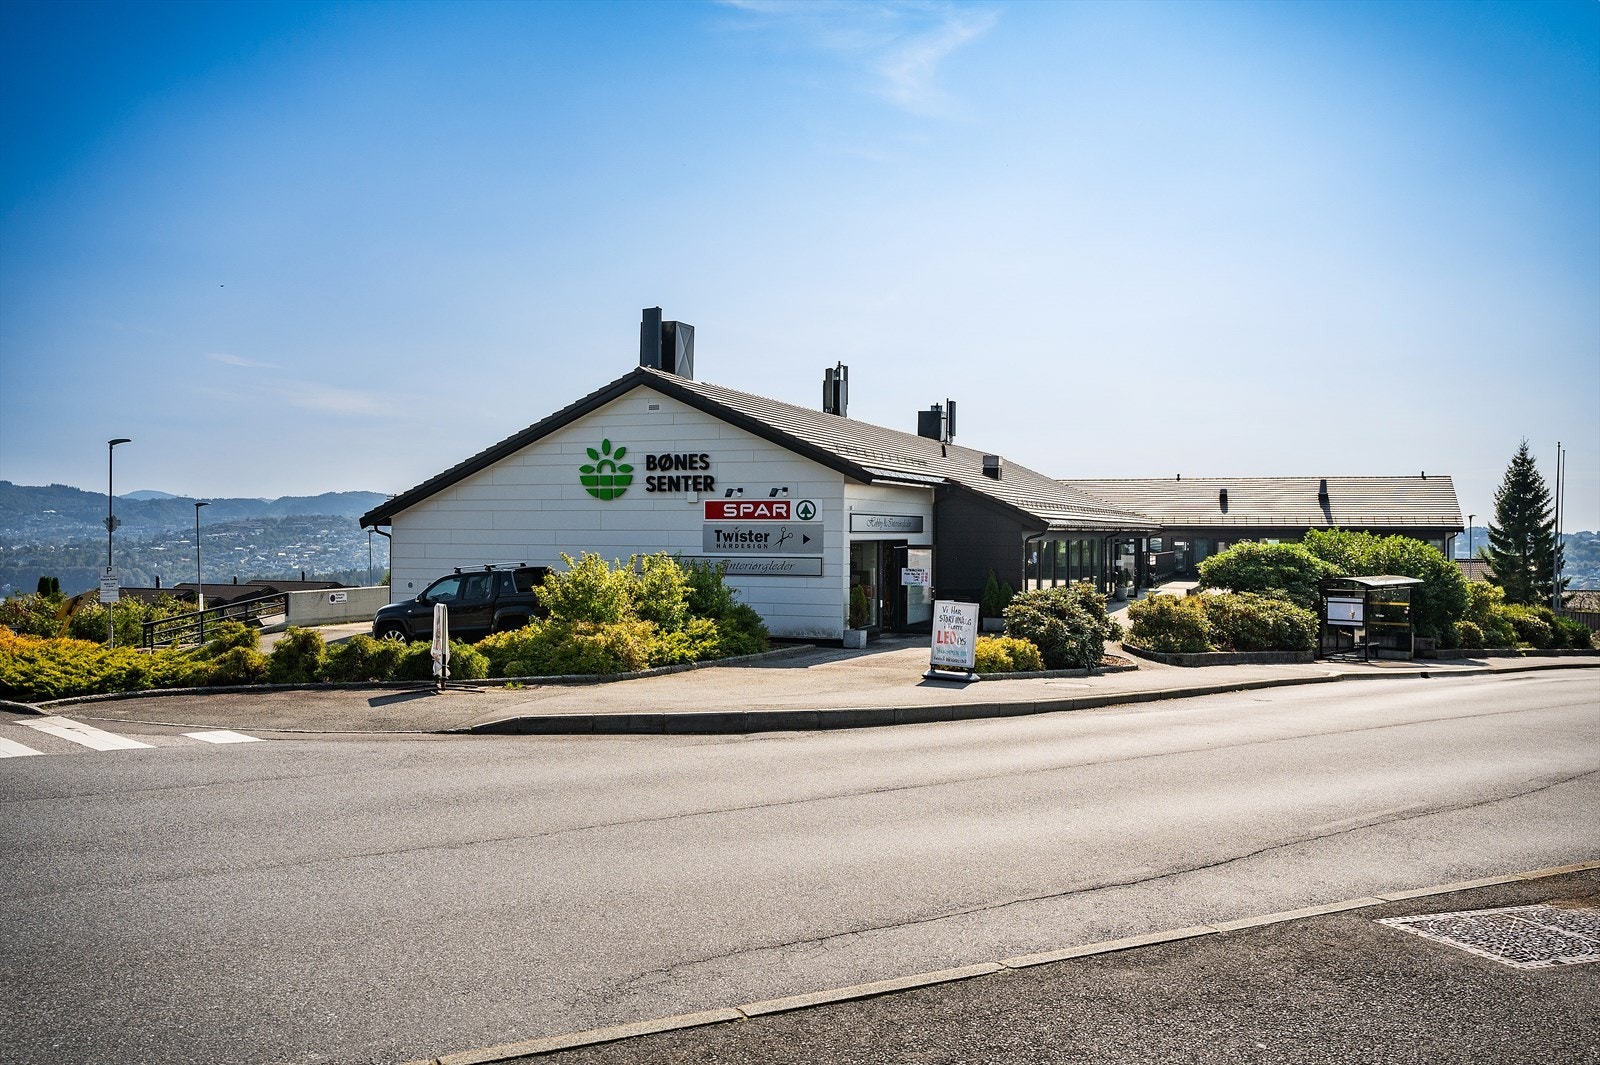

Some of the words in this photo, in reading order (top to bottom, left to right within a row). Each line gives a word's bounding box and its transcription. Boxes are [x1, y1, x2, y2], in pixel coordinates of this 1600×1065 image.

[645, 453, 710, 472] BØNES
[645, 475, 715, 492] SENTER
[723, 503, 787, 517] SPAR
[714, 527, 770, 543] Twister
[106, 566, 112, 575] P
[936, 630, 957, 645] LED
